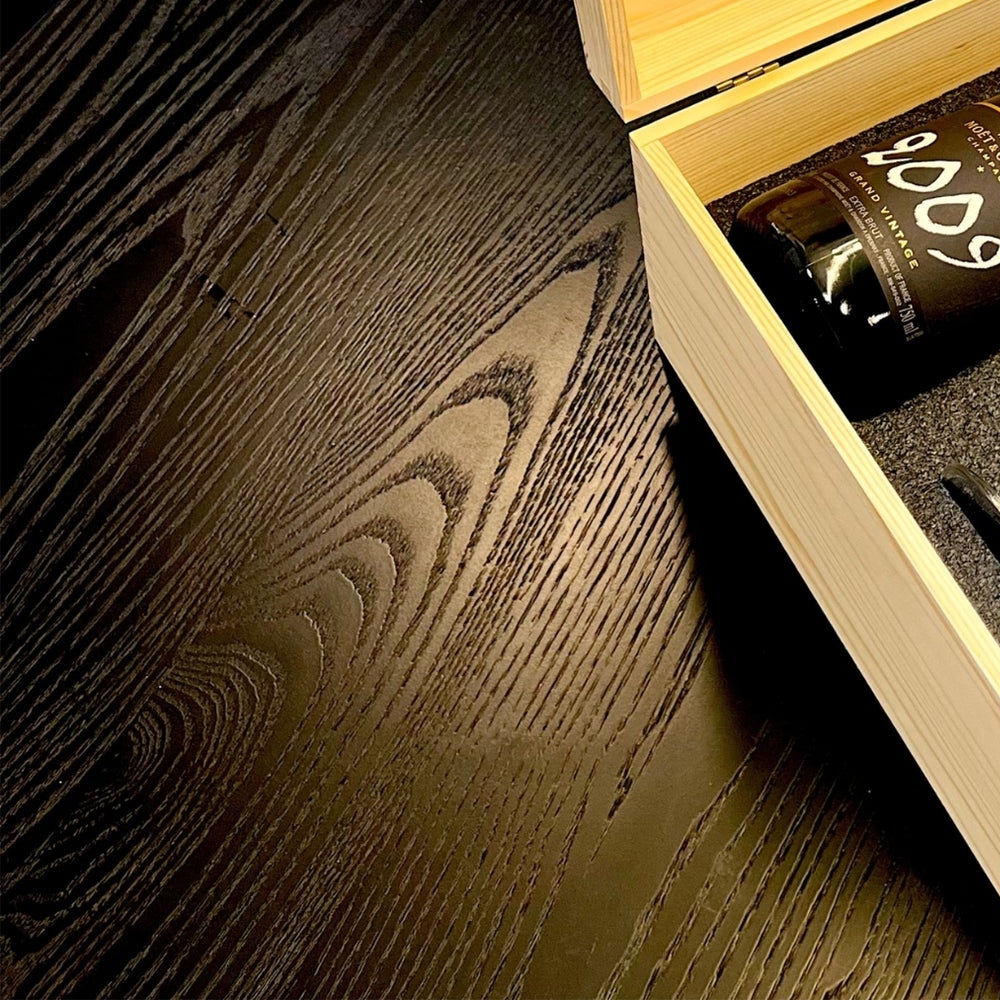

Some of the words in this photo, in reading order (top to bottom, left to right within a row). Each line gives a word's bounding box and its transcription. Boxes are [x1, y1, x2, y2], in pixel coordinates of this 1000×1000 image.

[988, 143, 999, 153] &
[848, 195, 869, 218] EXTRA
[865, 217, 884, 239] BRUT
[848, 171, 881, 202] GRAND
[880, 205, 919, 270] VINTAGE
[883, 247, 900, 273] PRODUCT
[894, 272, 903, 281] OF
[897, 280, 912, 304] FRANCE
[899, 304, 917, 323] 750
